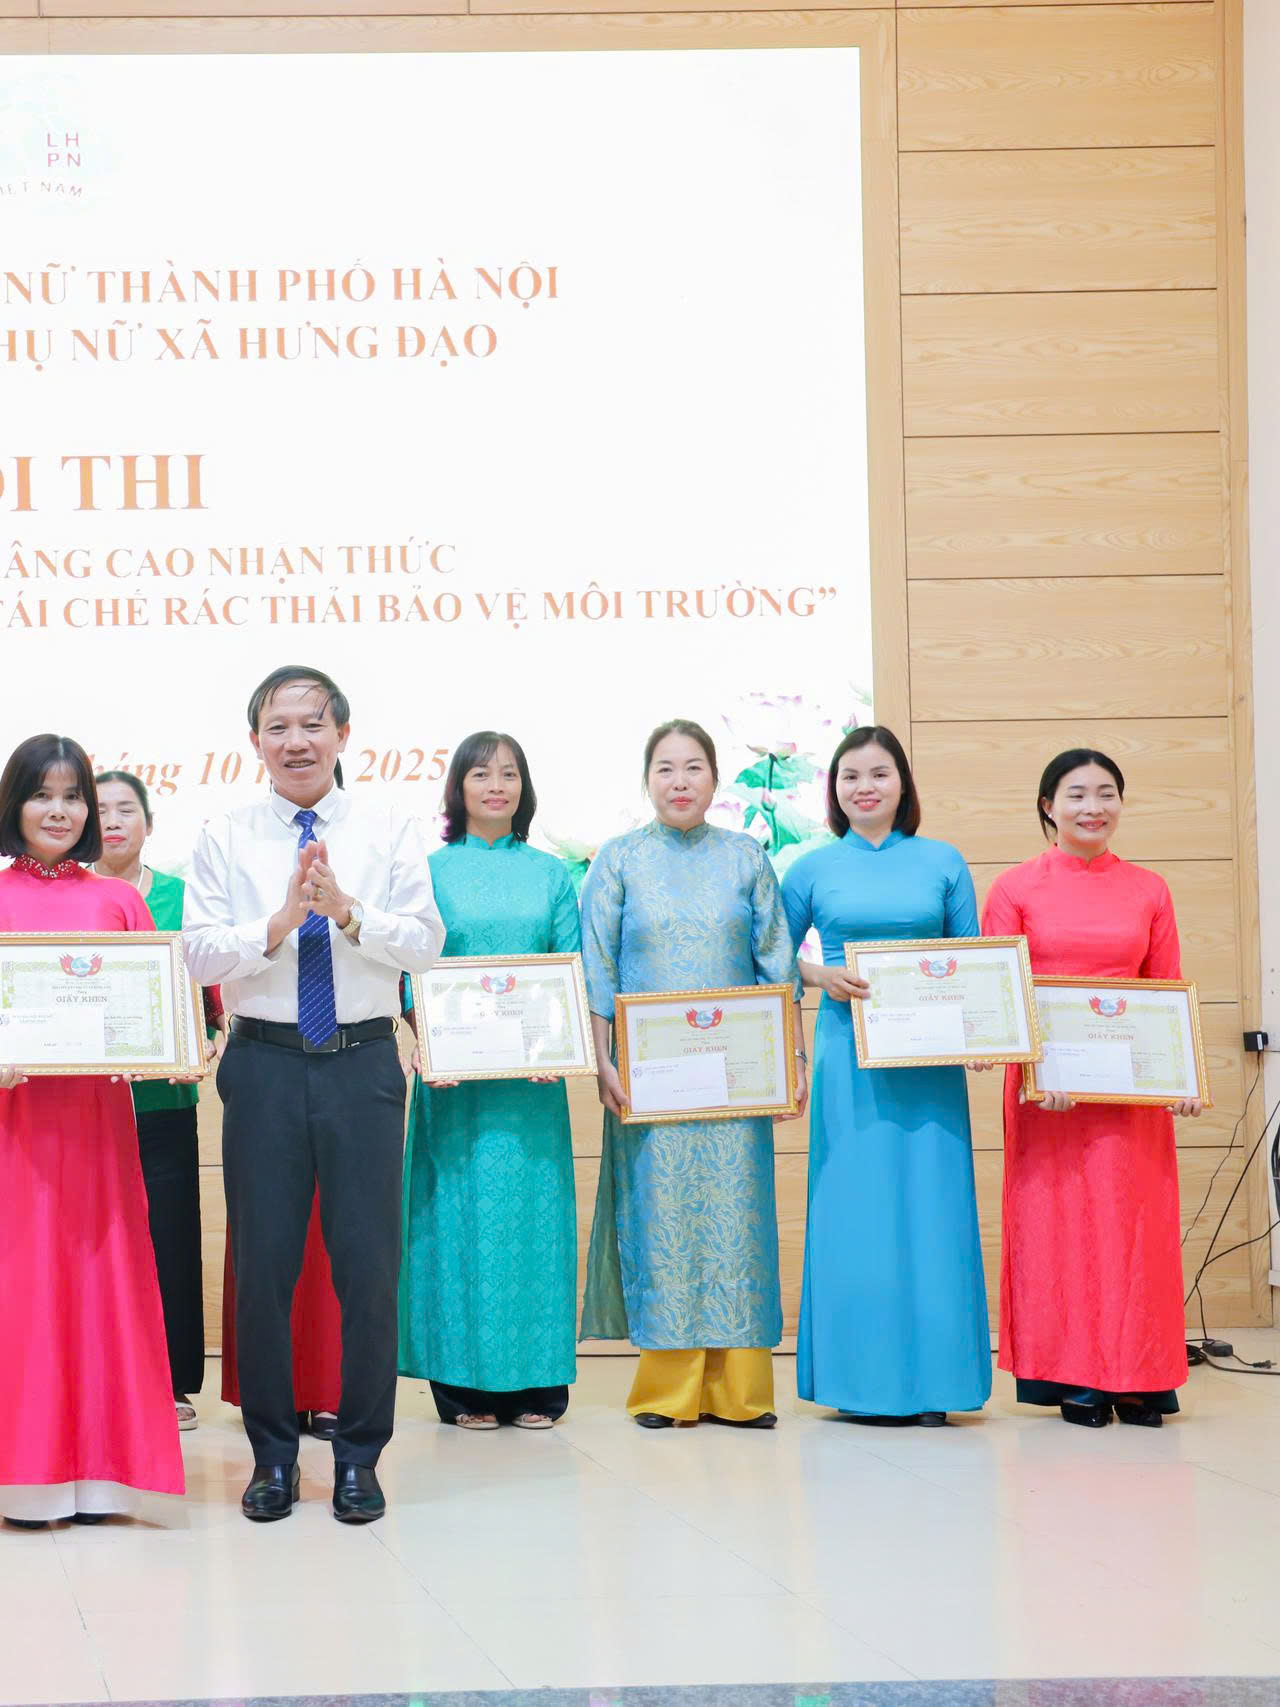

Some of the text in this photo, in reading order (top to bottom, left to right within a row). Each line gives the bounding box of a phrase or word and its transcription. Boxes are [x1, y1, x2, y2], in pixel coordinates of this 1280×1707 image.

[4, 263, 76, 304] NỮ
[87, 260, 257, 304] THÀNH
[278, 259, 376, 302] PHỐ
[392, 258, 457, 300] HÀ
[474, 261, 558, 309] NỘI
[72, 320, 142, 361] NỮ
[155, 319, 219, 360] XÃ
[239, 321, 378, 360] HƯNG
[397, 324, 497, 367] ĐẠO
[61, 454, 208, 511] THI
[106, 548, 194, 578] CAO
[208, 543, 323, 584] NHẬN
[337, 536, 455, 574] THỨC
[64, 589, 149, 628] CHẾ
[164, 588, 248, 625] RÁC
[261, 585, 360, 624] THẢI
[378, 585, 462, 623] BẢO
[475, 592, 528, 629] VỆ
[544, 581, 623, 620] MÔI
[199, 751, 242, 785] 10
[355, 748, 450, 782] 2025
